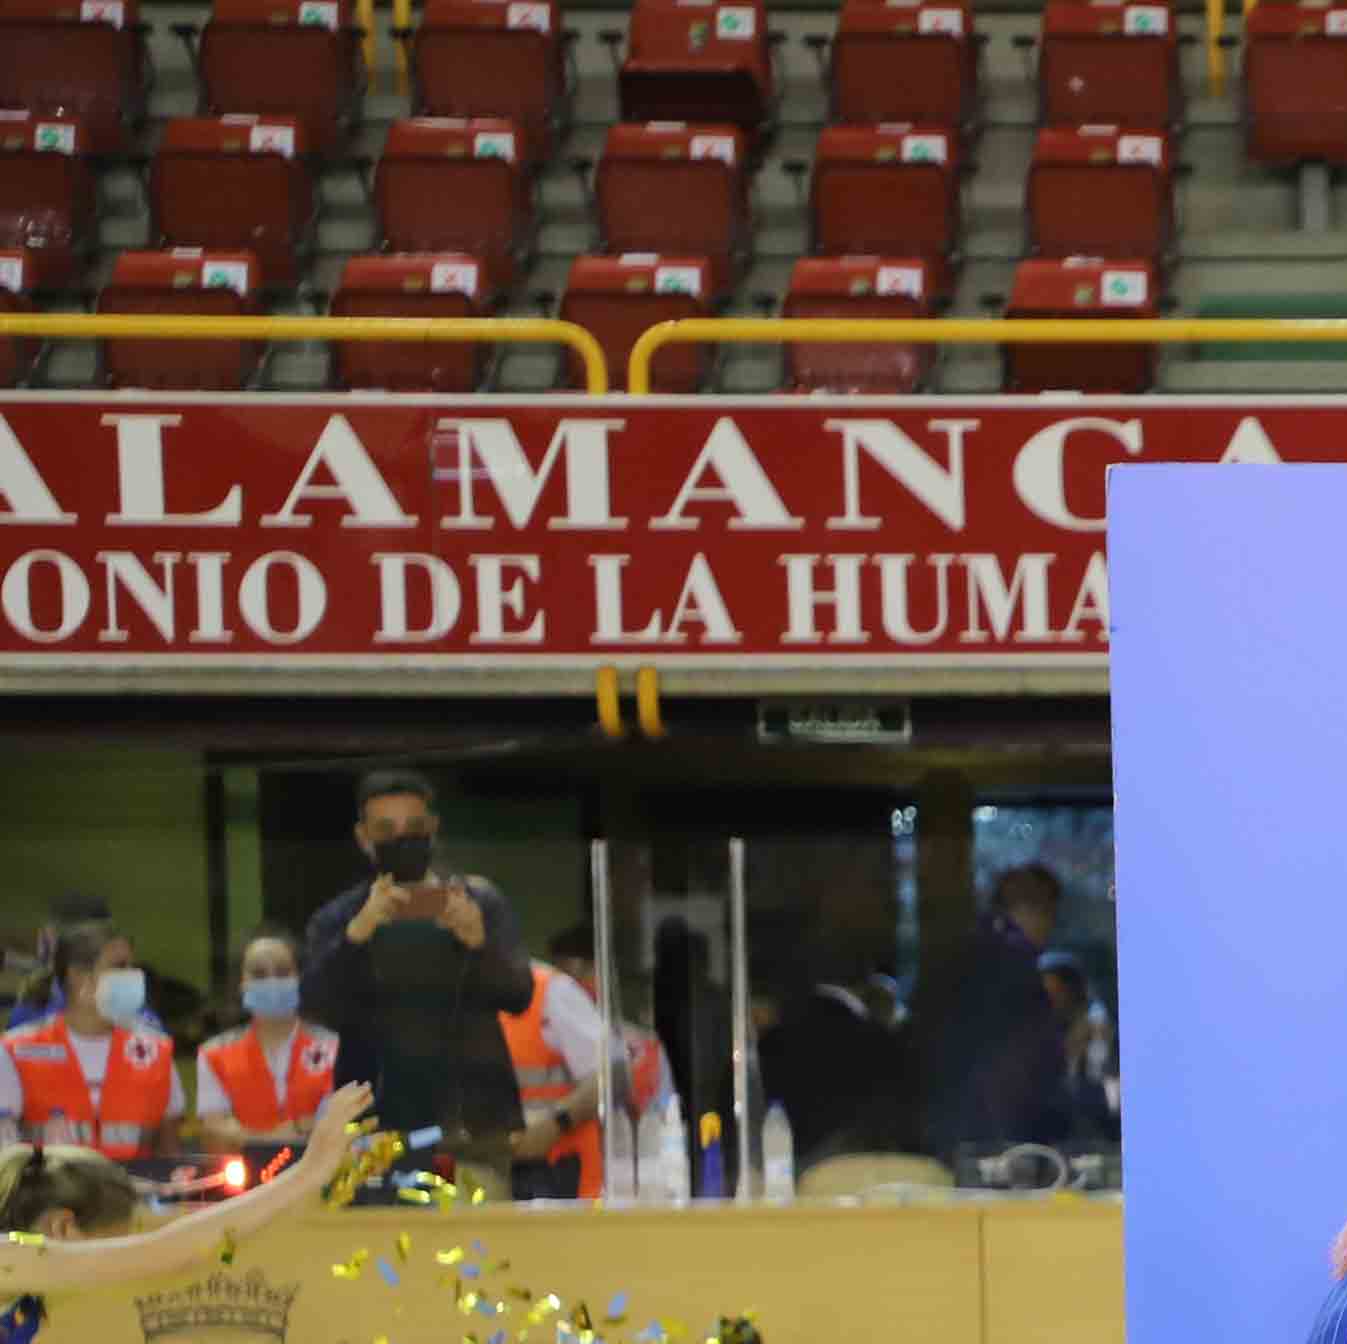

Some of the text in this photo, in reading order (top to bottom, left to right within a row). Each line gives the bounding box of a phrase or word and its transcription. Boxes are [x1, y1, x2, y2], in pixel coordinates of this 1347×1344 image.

[1, 549, 329, 644] ONIO
[371, 551, 546, 645] DE
[588, 552, 740, 645] LA
